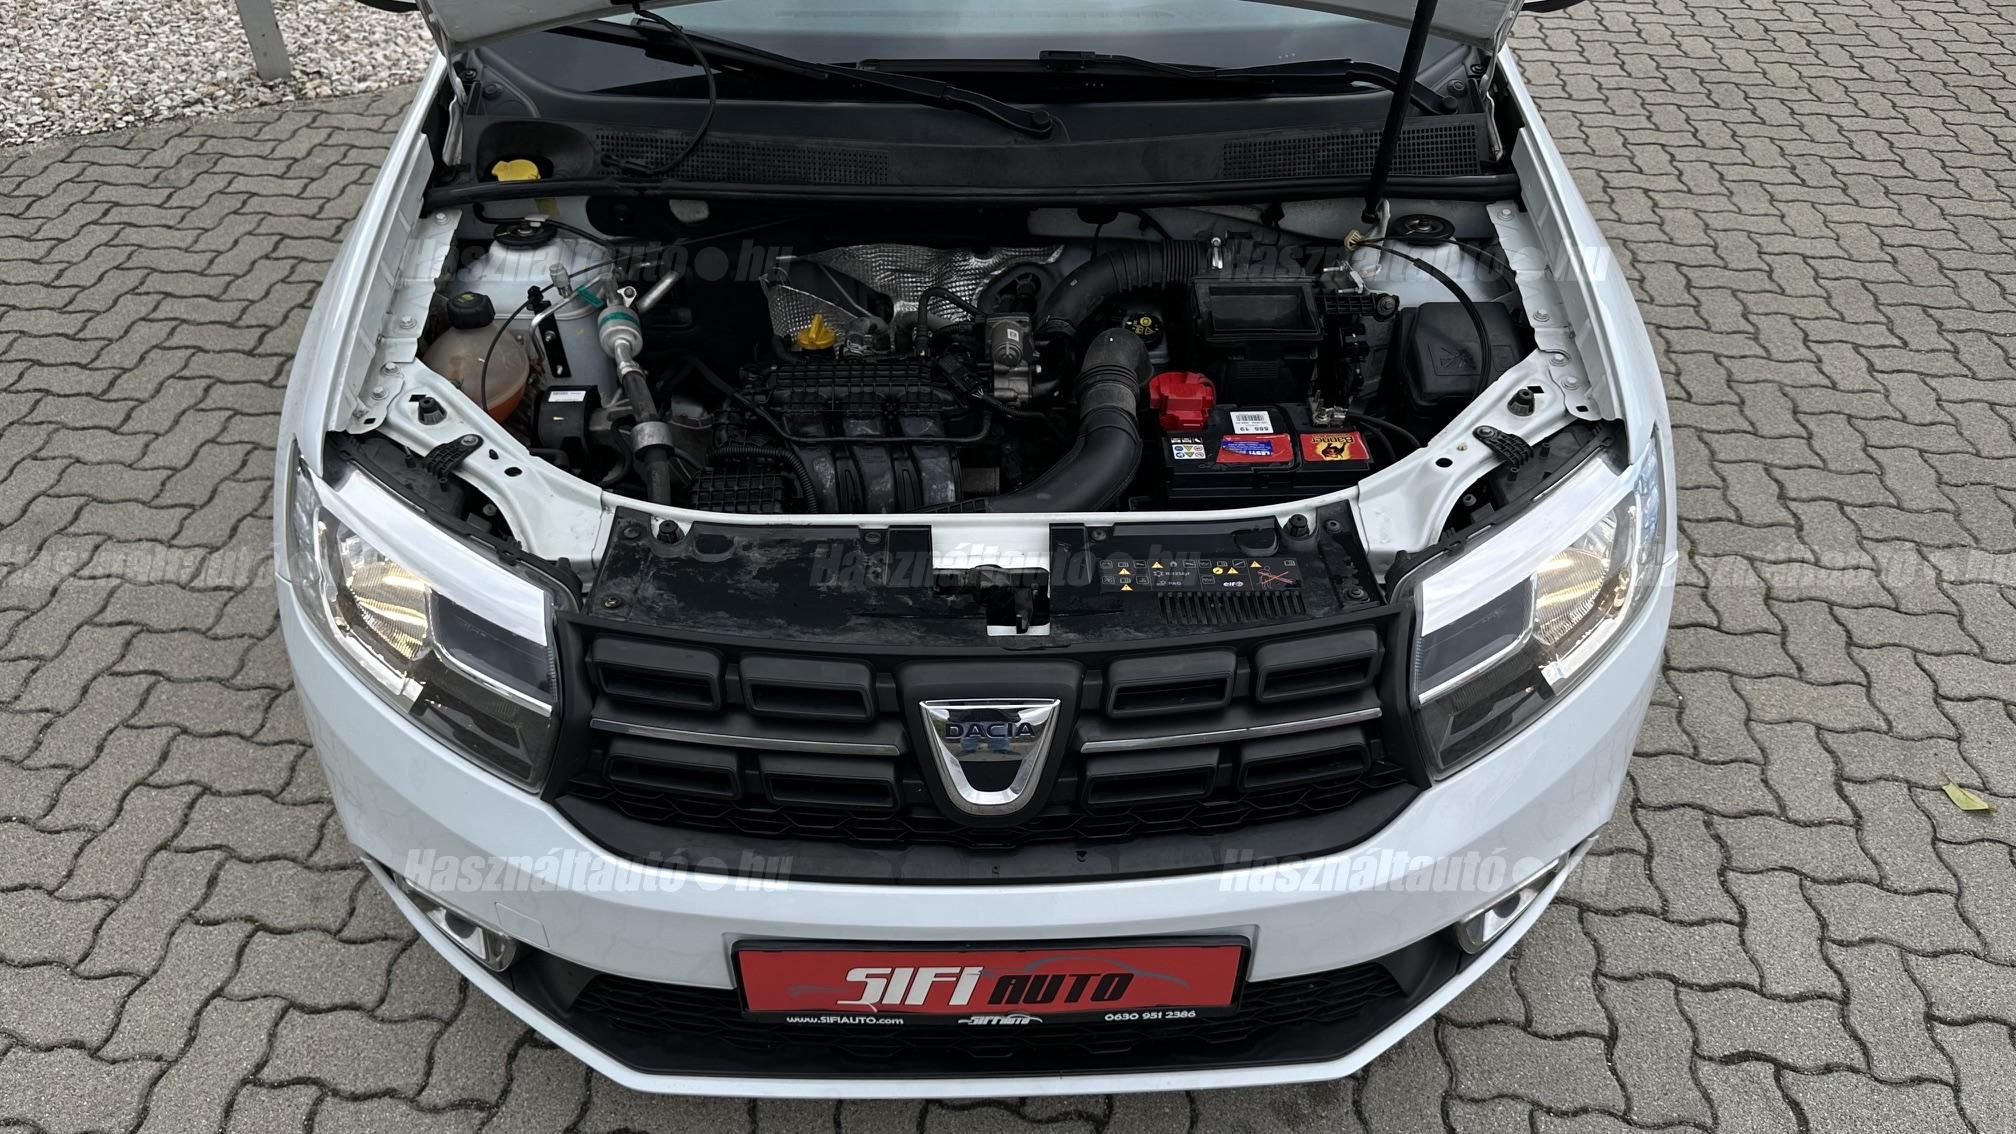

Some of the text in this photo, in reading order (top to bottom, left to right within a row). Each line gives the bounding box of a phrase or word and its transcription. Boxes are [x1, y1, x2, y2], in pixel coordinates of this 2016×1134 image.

[945, 722, 1035, 738] DACIA
[837, 966, 1135, 1013] SIFI AUTO
[786, 1016, 904, 1024] www.SIFIAUTO.com
[1104, 1013, 1139, 1021] 0630
[1165, 1010, 1196, 1018] 2386
